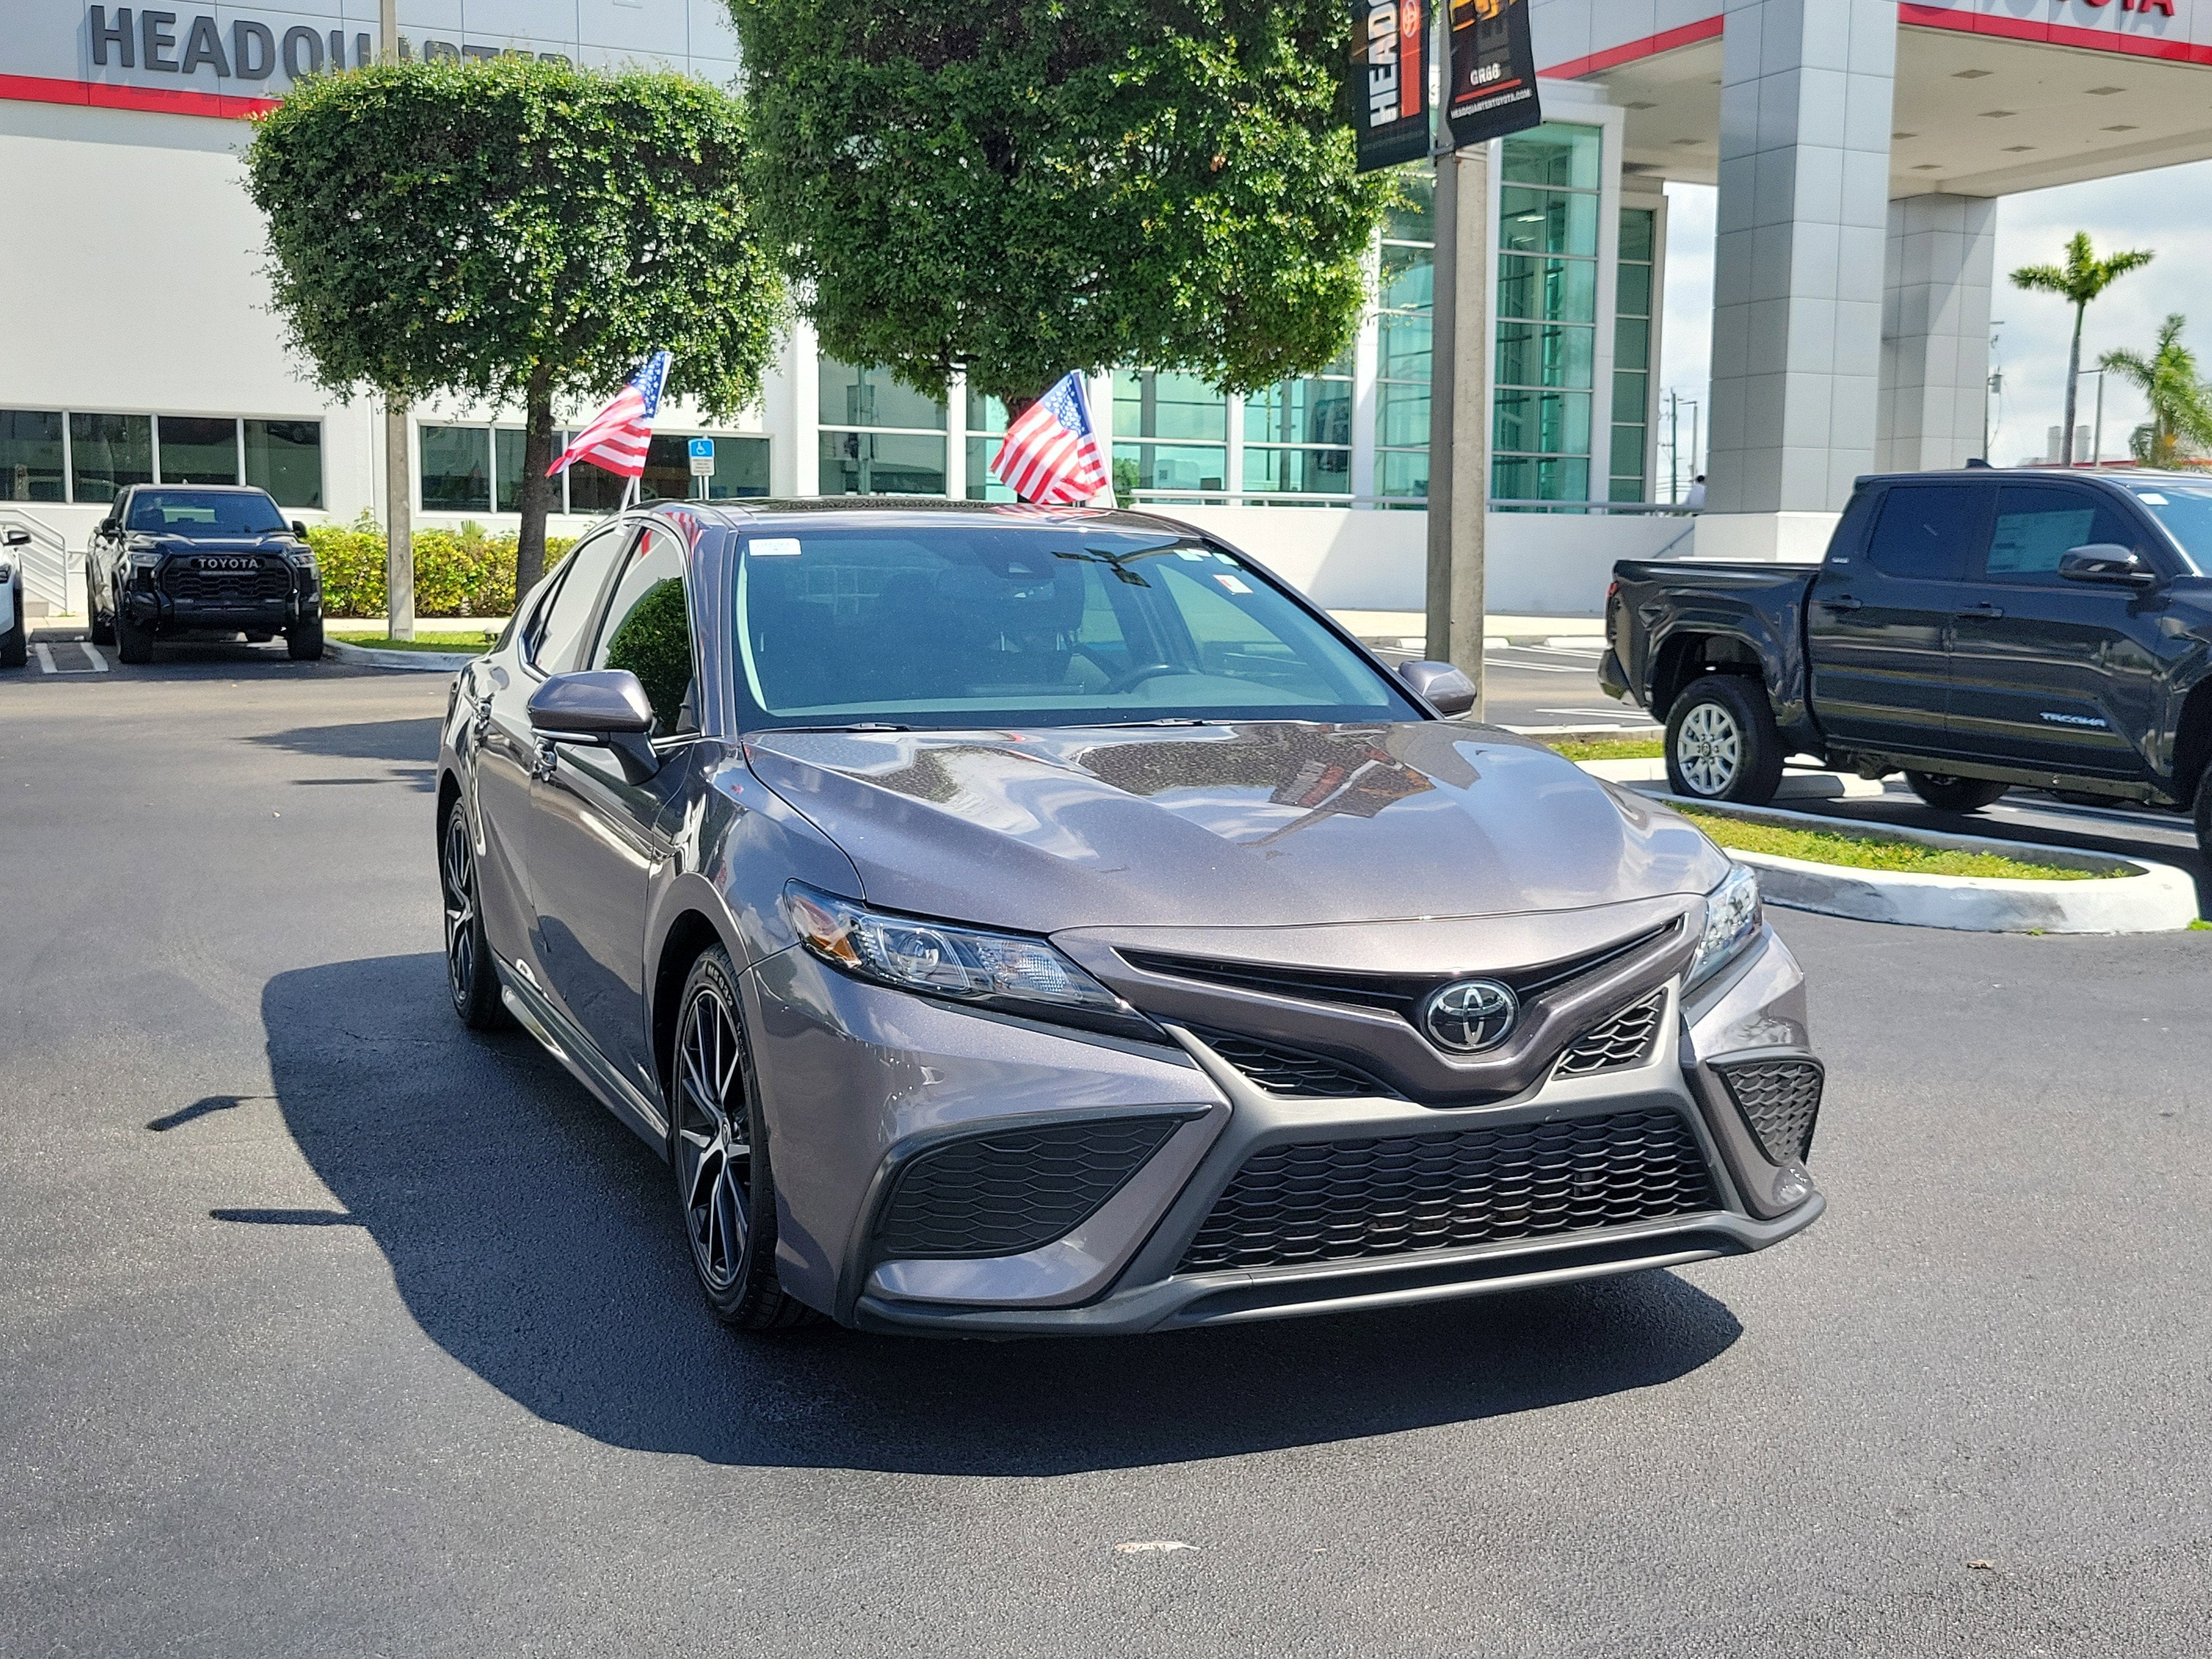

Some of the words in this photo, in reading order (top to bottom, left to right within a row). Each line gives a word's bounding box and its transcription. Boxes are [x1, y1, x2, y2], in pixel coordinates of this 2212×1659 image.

[1368, 0, 1398, 127] HEAD
[198, 558, 258, 569] TOYOTA
[2040, 712, 2107, 727] TACOMA
